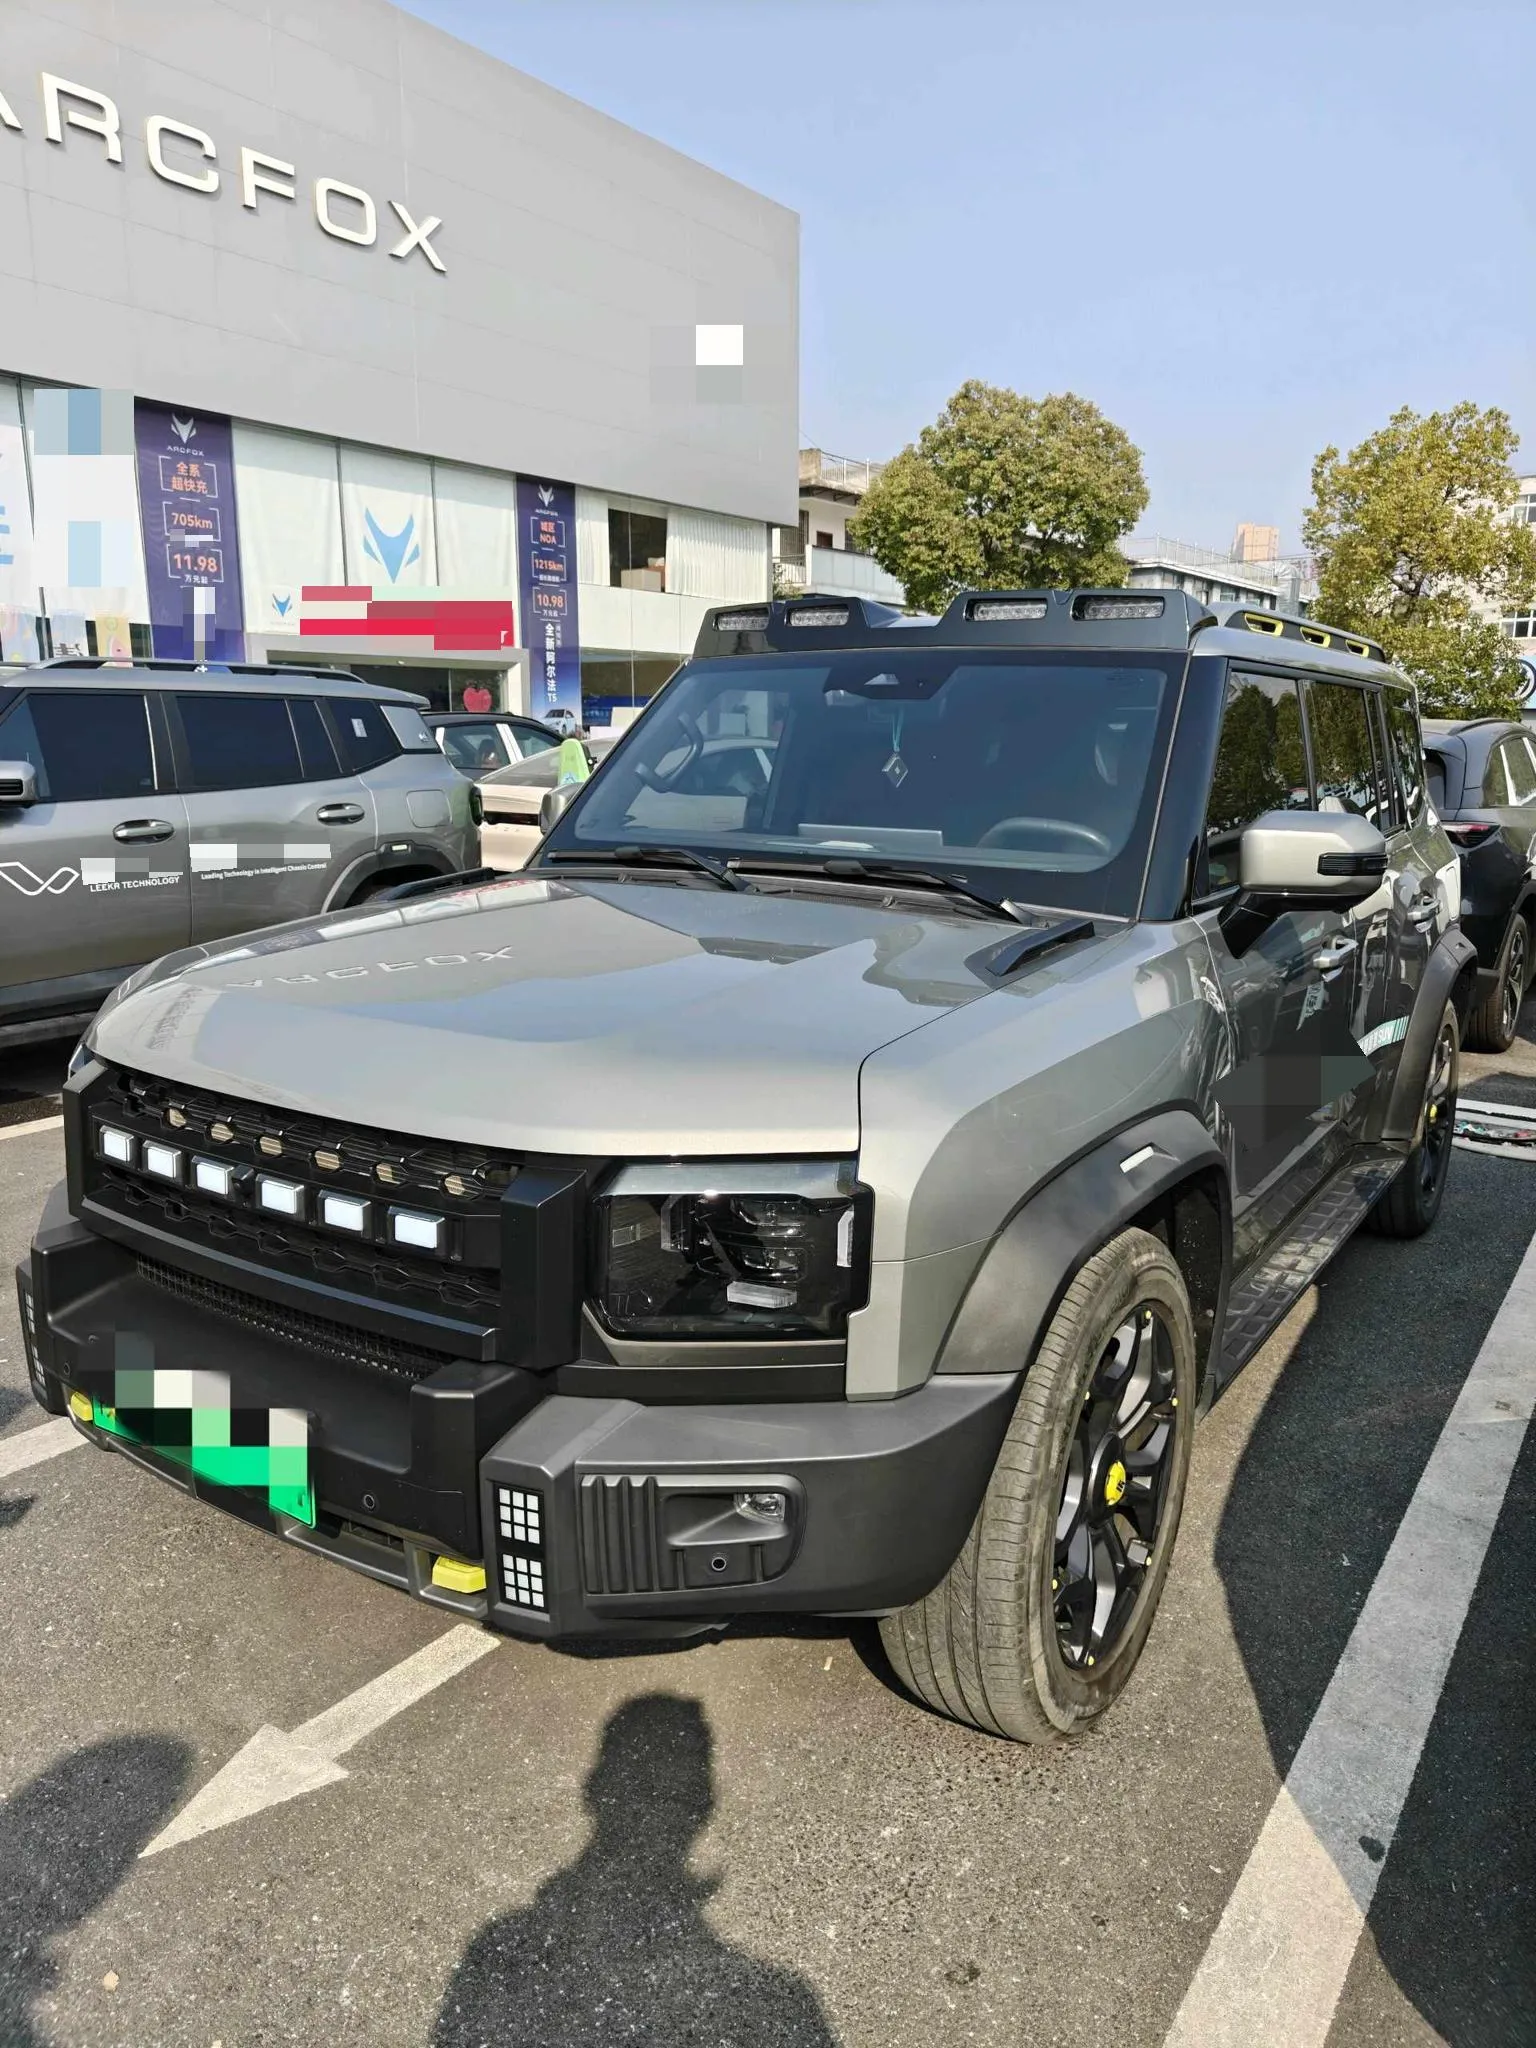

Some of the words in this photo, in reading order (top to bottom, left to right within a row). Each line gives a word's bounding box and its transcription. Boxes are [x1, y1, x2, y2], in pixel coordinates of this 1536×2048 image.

[166, 445, 204, 457] ARCFOX
[176, 461, 200, 477] 全系
[171, 476, 208, 494] 超快充
[171, 512, 213, 529] 705km
[173, 553, 218, 573] 11.98
[534, 558, 564, 572] 1215km
[537, 594, 564, 608] 10.98
[90, 882, 120, 892] LEEKR
[122, 876, 180, 889] TECHNOLOGY
